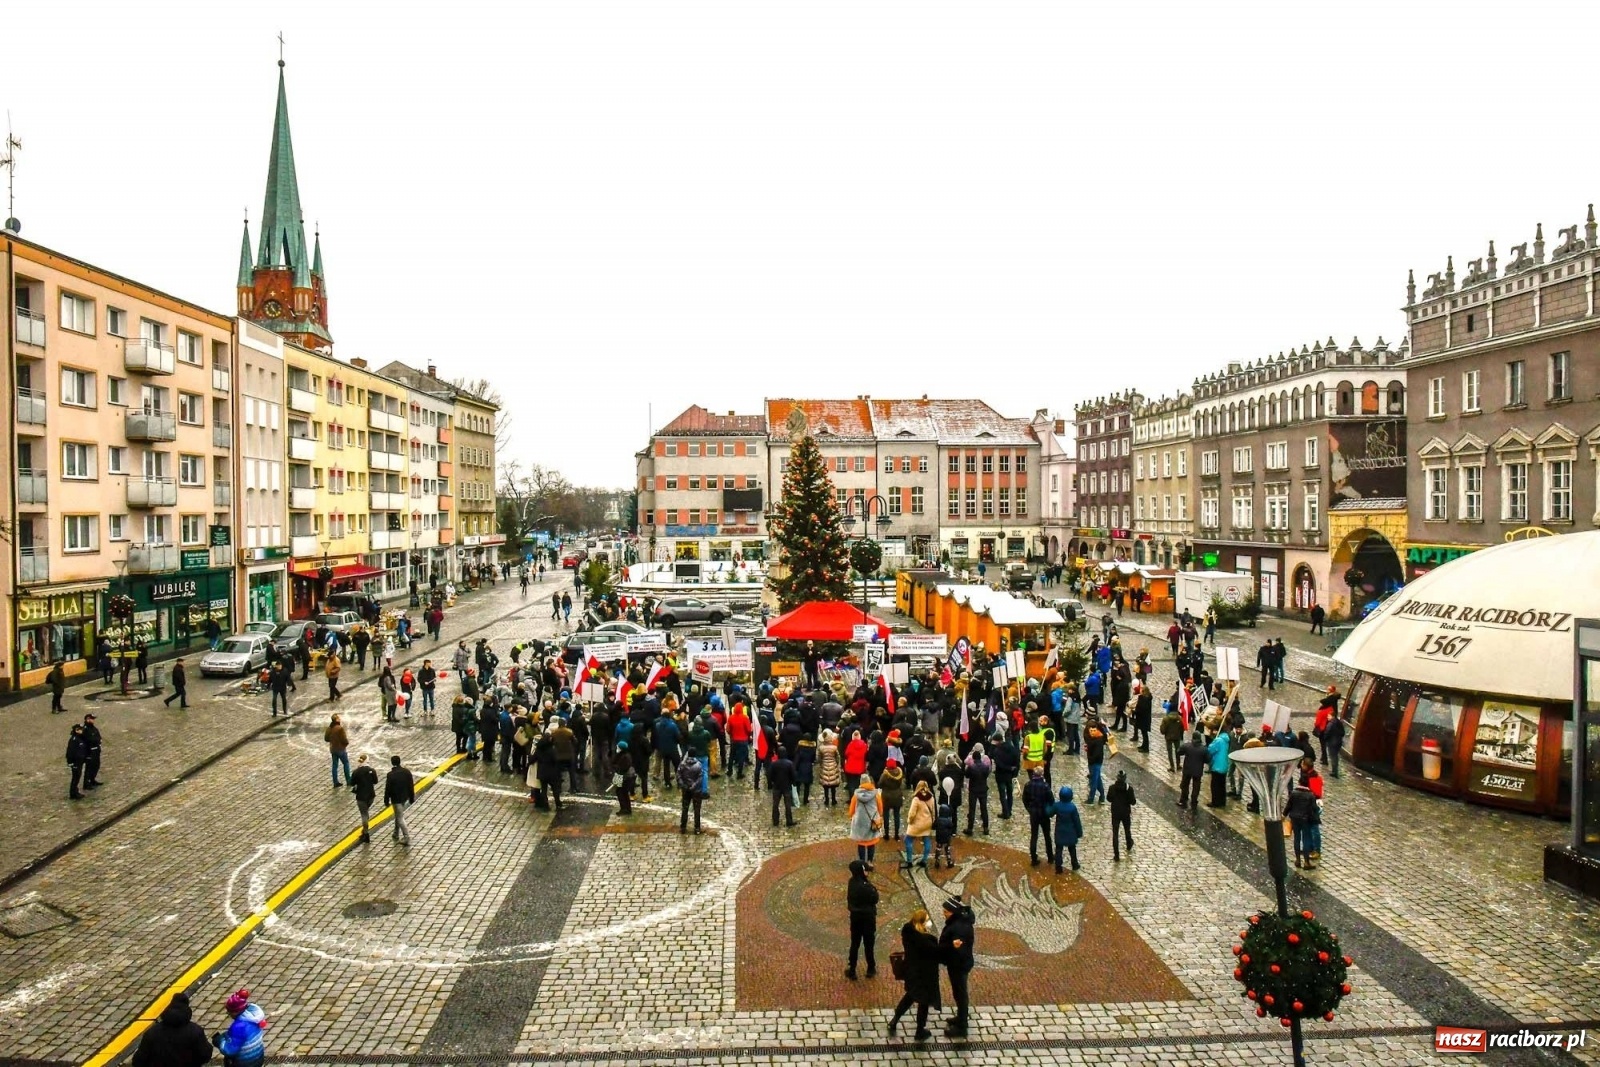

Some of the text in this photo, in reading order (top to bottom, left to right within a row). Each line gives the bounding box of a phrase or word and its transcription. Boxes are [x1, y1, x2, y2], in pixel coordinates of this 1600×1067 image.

[153, 581, 196, 595] JUBILER
[19, 598, 80, 620] STELLA
[210, 600, 227, 608] CASIO
[1391, 599, 1572, 632] BROWAR RACIBÓRZ
[1439, 622, 1457, 631] Rok
[702, 641, 709, 651] 3
[1416, 633, 1472, 658] 1567
[1481, 775, 1506, 786] 450
[1505, 780, 1525, 789] LAT
